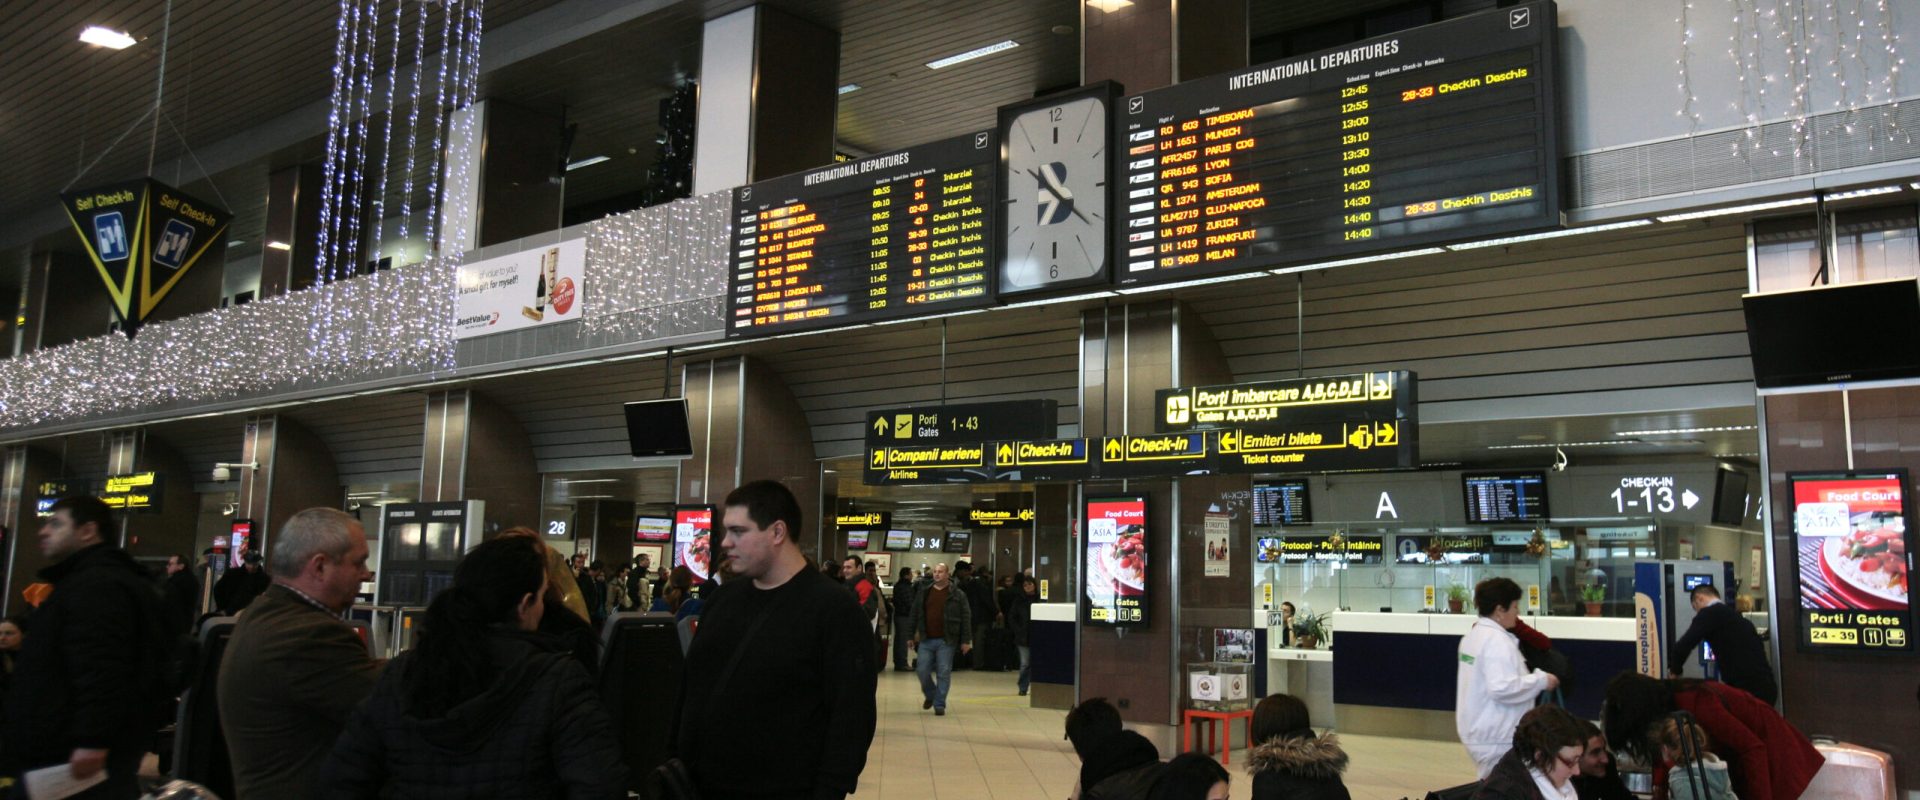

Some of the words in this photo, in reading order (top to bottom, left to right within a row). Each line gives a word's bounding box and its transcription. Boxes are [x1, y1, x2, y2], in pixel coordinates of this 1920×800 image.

[1230, 61, 1317, 90] INTERNATIONAL
[1321, 40, 1399, 70] DEPARTURES
[1049, 108, 1062, 122] 12
[1161, 141, 1172, 150] LH
[1177, 136, 1196, 147] 1651
[1206, 126, 1240, 140] MUNICH
[1342, 100, 1368, 113] 12:55
[1402, 87, 1433, 101] 28-33
[1486, 69, 1527, 84] Deschis
[1161, 126, 1173, 135] RO
[1182, 120, 1198, 131] 603
[1206, 109, 1253, 126] TIMISOARA
[1342, 85, 1368, 98] 12:45
[1162, 150, 1197, 164] AFR2457
[1206, 144, 1231, 155] PARIS
[1236, 139, 1254, 149] CDG
[1342, 116, 1368, 129] 13:00
[1162, 165, 1197, 178] AFR6166
[1206, 159, 1229, 170] LYON
[1343, 132, 1369, 144] 13:10
[804, 164, 858, 186] INTERNATIONAL
[861, 152, 909, 173] DEPARTURES
[1161, 182, 1173, 194] QR
[1182, 180, 1198, 189] 943
[1206, 174, 1231, 185] SOFIA
[1343, 148, 1369, 161] 13:30
[915, 179, 923, 187] 07
[1161, 200, 1171, 208] KL
[1177, 195, 1196, 206] 1374
[1206, 182, 1259, 200] AMSTERDAM
[1343, 164, 1370, 176] 14:00
[76, 197, 94, 211] Self
[160, 194, 177, 210] Self
[873, 199, 890, 208] 09:10
[1161, 209, 1198, 222] KLM2719
[1206, 198, 1265, 215] CLUJ-NAPOCA
[1344, 180, 1370, 192] 14:20
[872, 211, 890, 221] 09:25
[909, 204, 928, 213] 02-03
[872, 224, 888, 233] 10:35
[962, 207, 982, 216] Inchis
[1161, 229, 1172, 237] UA
[1177, 224, 1197, 235] 9787
[1206, 218, 1238, 230] ZURICH
[1344, 196, 1370, 208] 14:30
[1161, 243, 1172, 252] LH
[1177, 239, 1197, 250] 1419
[1206, 230, 1256, 245] FRANKFURT
[1344, 212, 1371, 224] 14:40
[1405, 202, 1436, 215] 28-33
[1490, 187, 1532, 202] Deschis
[872, 237, 888, 246] 10:50
[962, 220, 982, 230] Inchis
[871, 249, 888, 258] 11:05
[961, 234, 981, 243] Inchis
[1161, 258, 1173, 267] RO
[1178, 254, 1198, 264] 9409
[1206, 249, 1235, 260] MILAN
[1344, 228, 1371, 240] 14:40
[871, 262, 887, 271] 11:35
[959, 246, 984, 256] Deschis
[785, 287, 808, 297] LONDON
[870, 274, 887, 283] 11:45
[958, 260, 983, 270] Deschis
[1050, 265, 1058, 278] 6
[464, 284, 478, 294] small
[480, 283, 488, 293] gift
[870, 287, 887, 296] 12:05
[908, 282, 925, 290] 19-21
[958, 273, 983, 283] Deschis
[869, 300, 886, 309] 12:20
[907, 295, 926, 303] 41-42
[958, 287, 983, 297] Deschis
[1302, 380, 1361, 400] A,B,C,D,E
[1196, 408, 1224, 422] Gates
[1226, 407, 1278, 421] A,B,C,D,E
[918, 427, 939, 437] Gates
[951, 418, 956, 431] 1
[966, 416, 978, 430] 43
[1130, 436, 1188, 453] Check-in
[1243, 433, 1284, 448] Emiteri
[1289, 431, 1321, 446] bilete
[889, 448, 937, 463] Companii
[940, 448, 980, 460] aeriene
[1019, 443, 1072, 458] Check-in
[1242, 454, 1269, 464] Ticket
[1270, 452, 1304, 463] counter
[889, 470, 918, 479] Airlines
[1621, 477, 1673, 487] CHECK-IN
[1611, 487, 1674, 513] 1-13
[1827, 492, 1858, 501] Food
[1862, 491, 1900, 501] Court
[1376, 491, 1397, 519] A
[548, 521, 566, 534] 28
[1806, 516, 1840, 527] ASIA
[914, 538, 925, 548] 33
[929, 538, 940, 548] 34
[1280, 542, 1312, 550] Protocol
[1810, 613, 1844, 623] Porti
[1856, 614, 1900, 625] Gates
[1813, 631, 1828, 639] 24
[1840, 631, 1855, 640] 39
